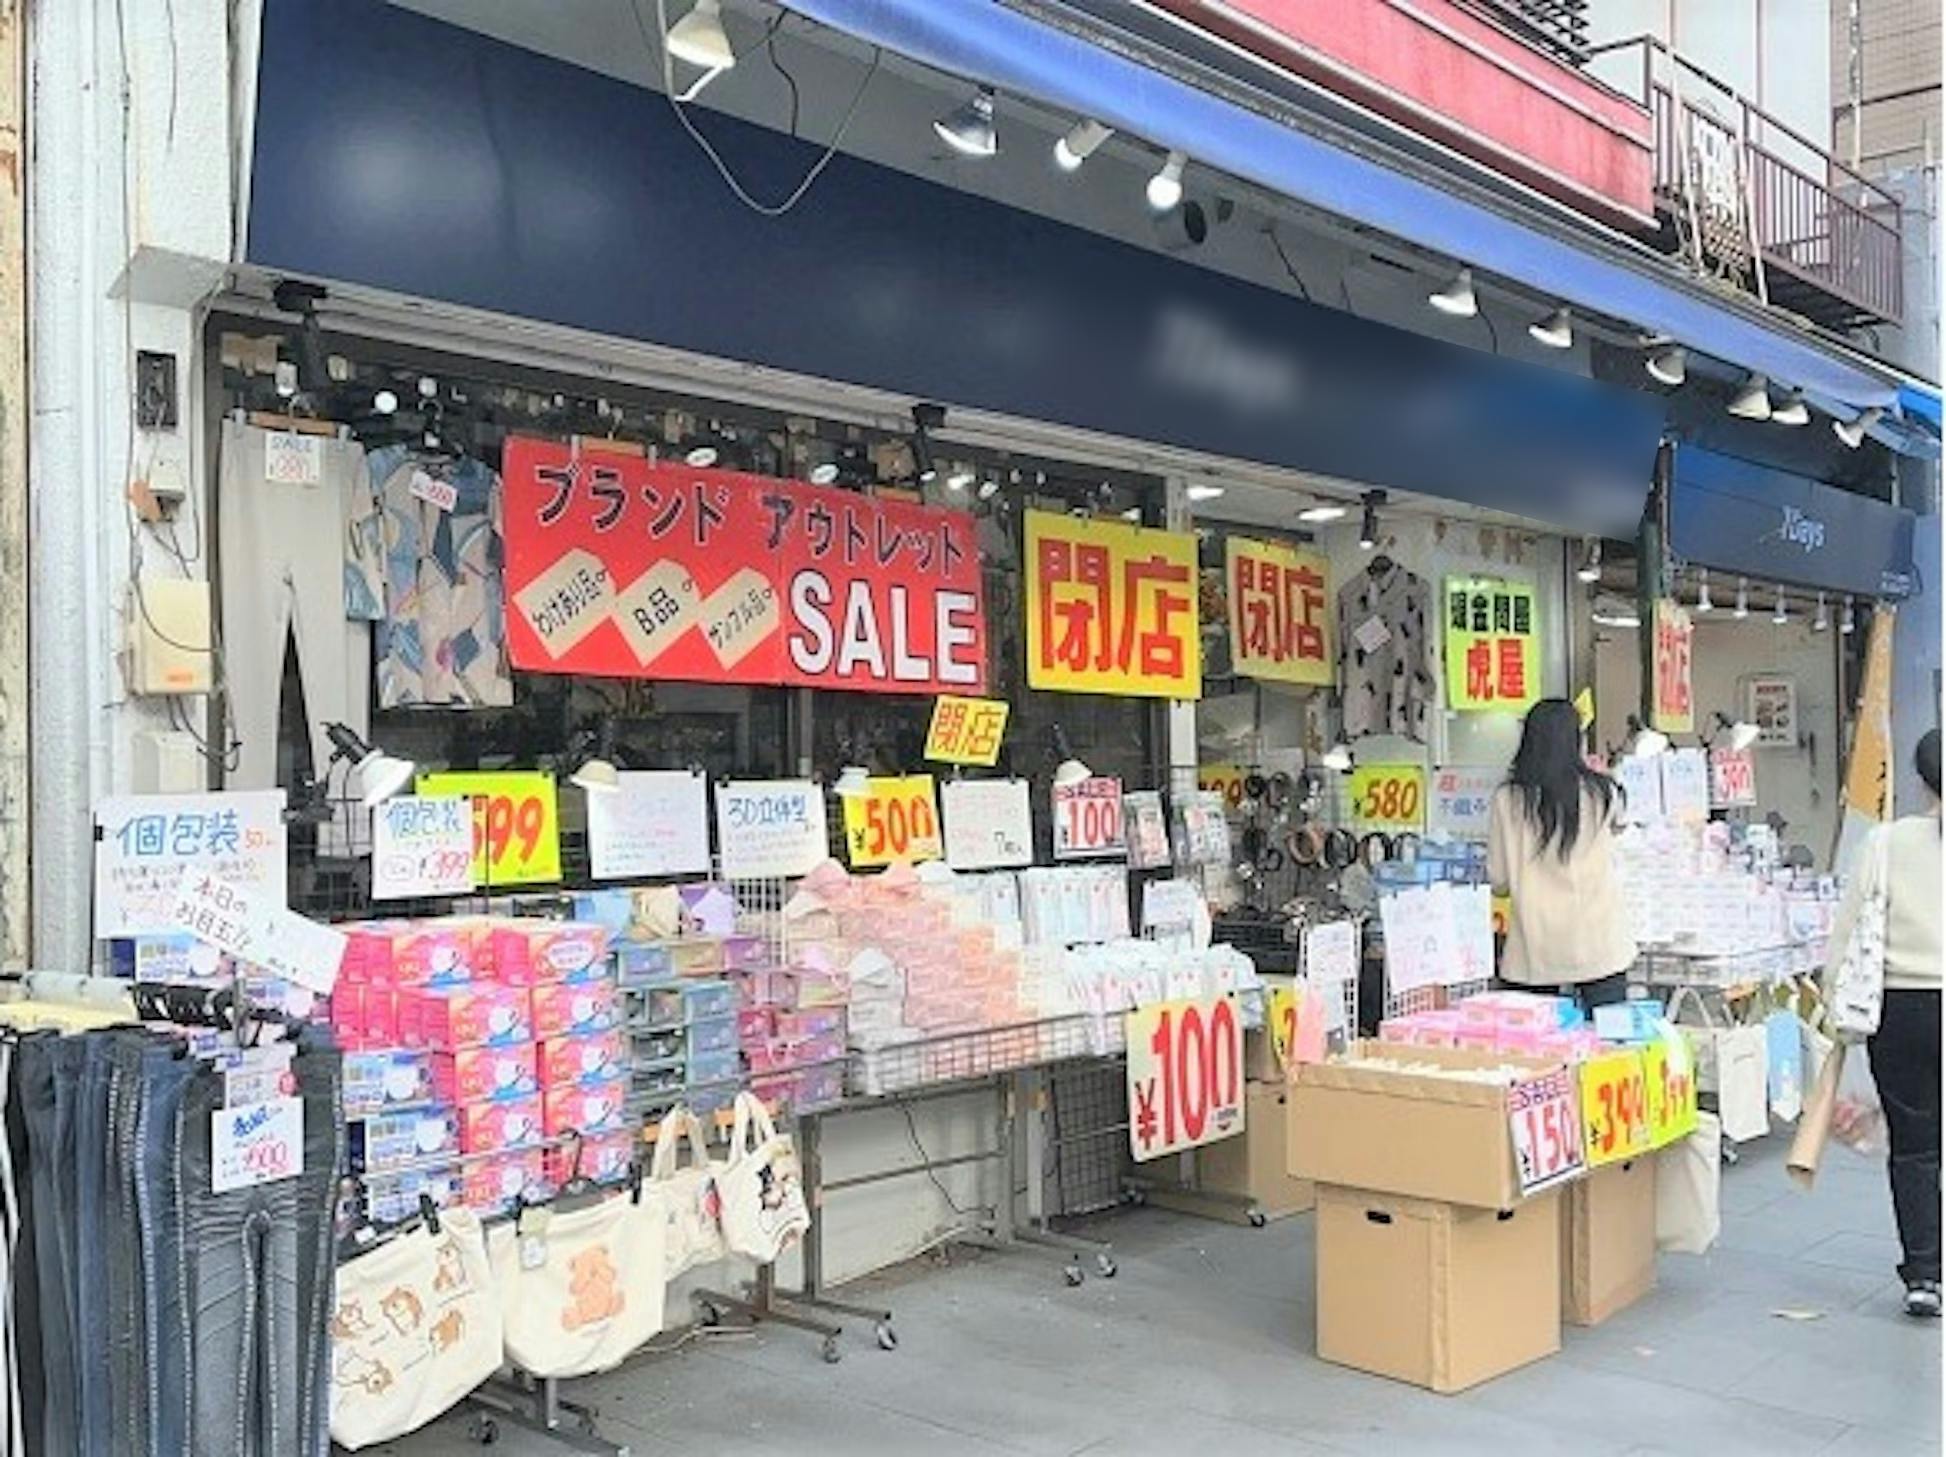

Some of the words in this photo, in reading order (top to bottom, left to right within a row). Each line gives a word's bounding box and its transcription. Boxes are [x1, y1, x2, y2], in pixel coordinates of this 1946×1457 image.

[534, 464, 729, 543] ブランド
[762, 492, 963, 578] アウトレット
[788, 568, 979, 684] SALE
[1038, 537, 1191, 679] 閉店
[1237, 555, 1325, 663] 閉店
[1467, 638, 1526, 701] 虎屋
[930, 702, 1000, 756] 閉店
[117, 808, 240, 857] 個包装
[1134, 1001, 1241, 1150] ¥100
